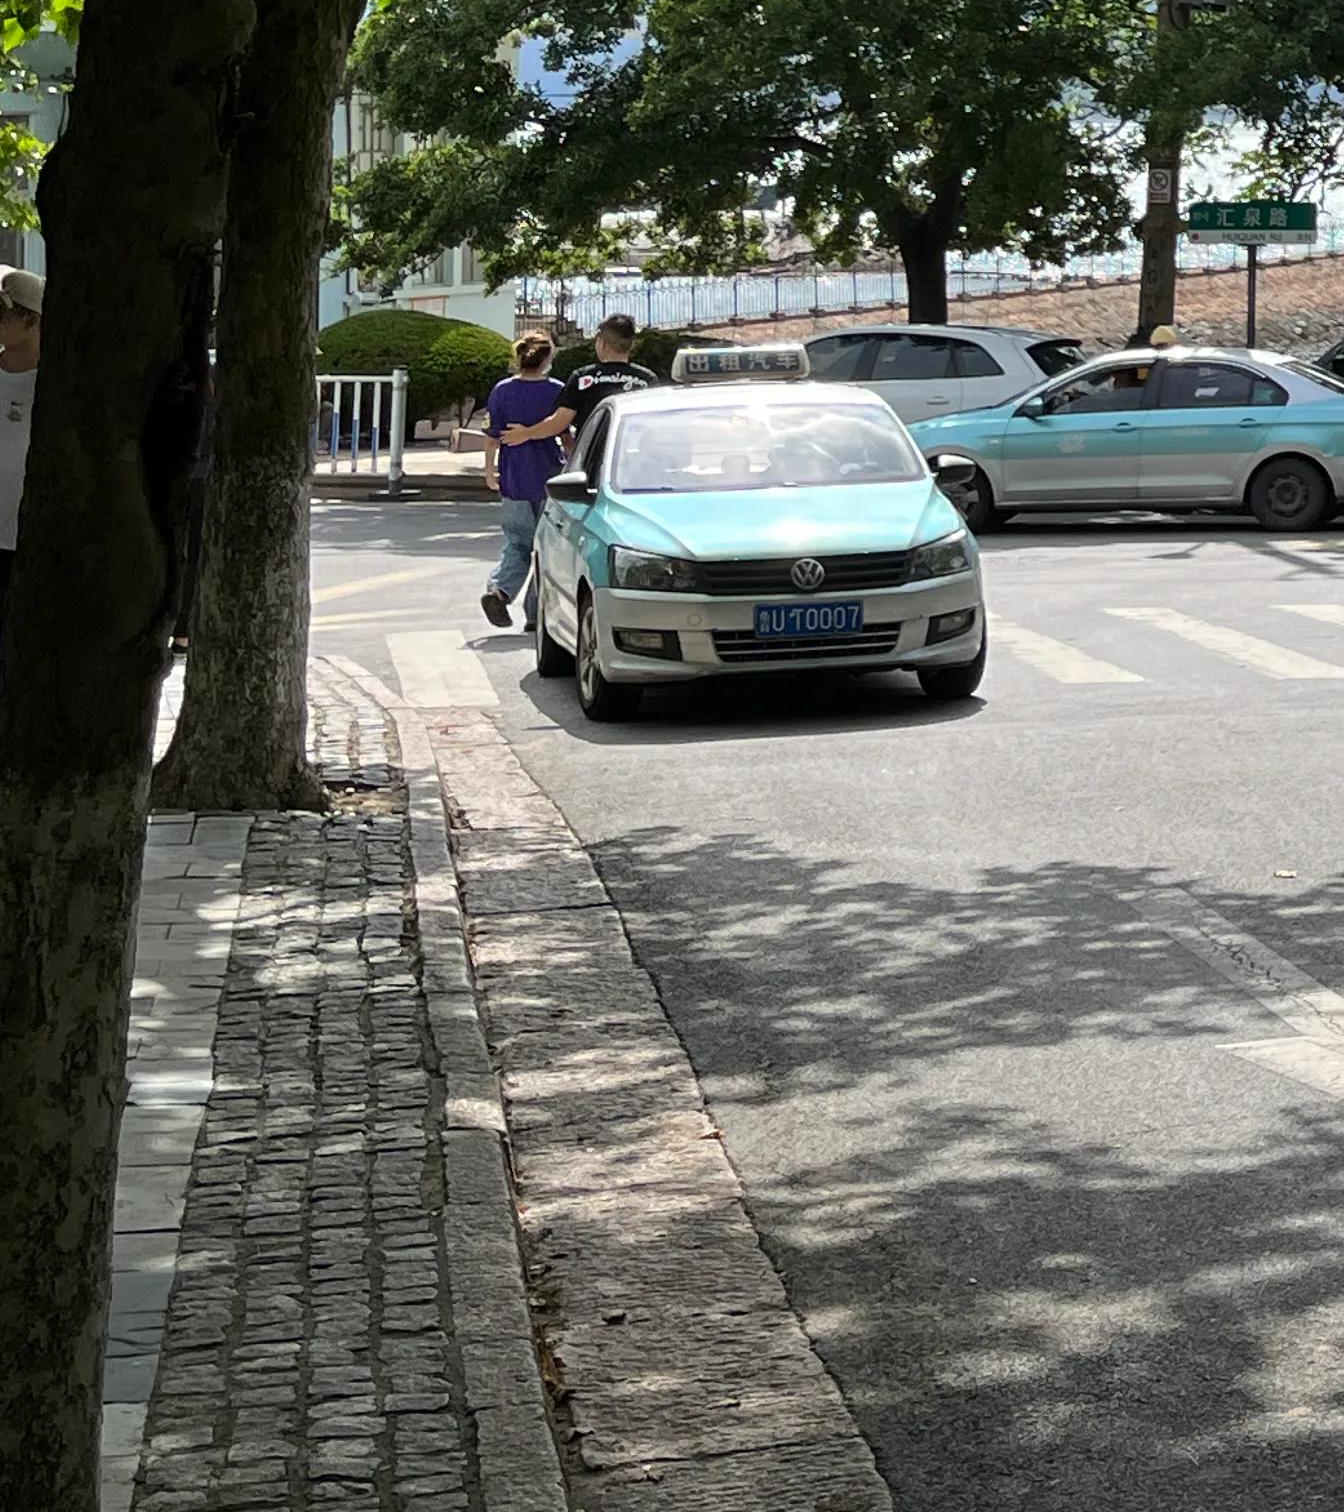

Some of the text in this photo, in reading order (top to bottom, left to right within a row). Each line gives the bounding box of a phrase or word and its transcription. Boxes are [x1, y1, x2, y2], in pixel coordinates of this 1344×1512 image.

[1217, 207, 1289, 228] 汇泉路
[688, 352, 800, 373] 出租汽车
